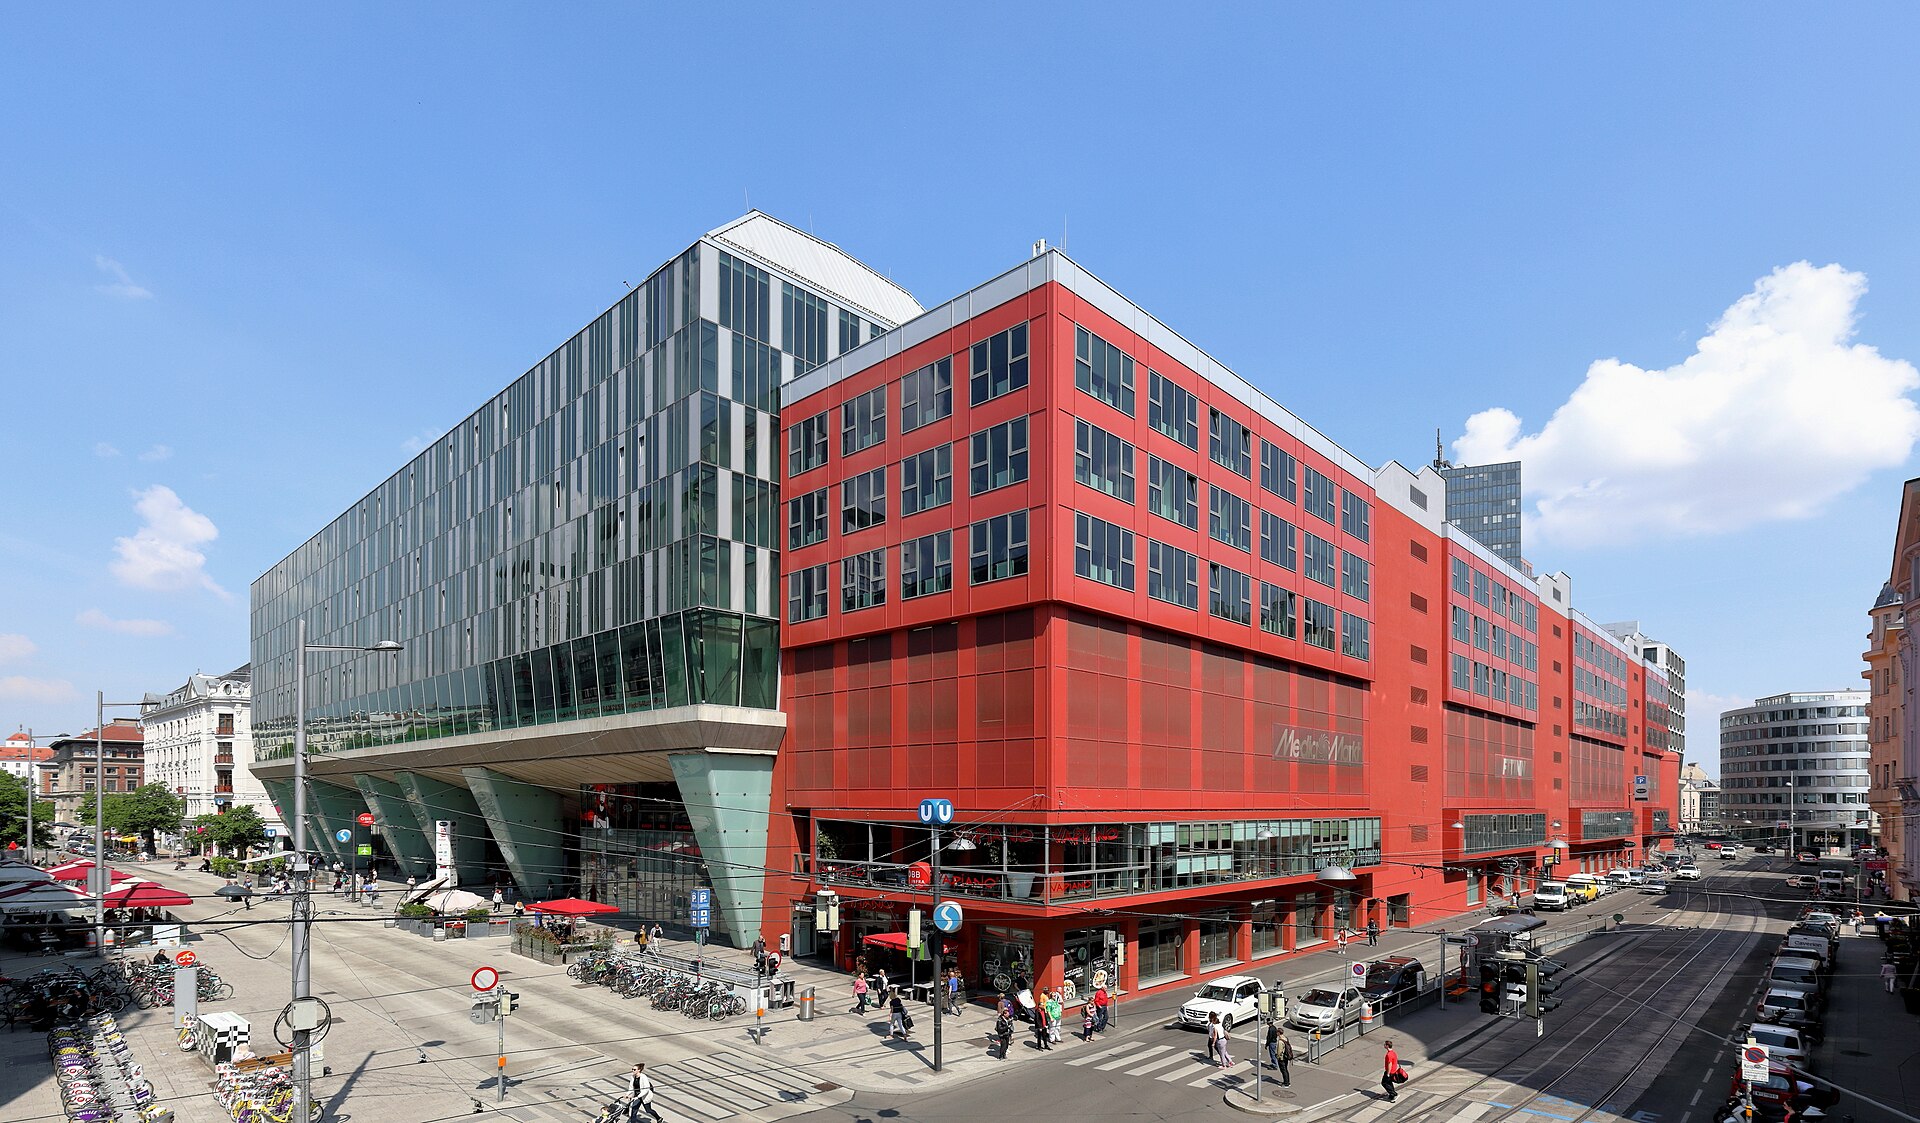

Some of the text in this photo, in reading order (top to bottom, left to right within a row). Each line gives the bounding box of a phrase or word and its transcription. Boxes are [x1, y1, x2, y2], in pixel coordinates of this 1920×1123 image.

[921, 805, 951, 821] U U
[267, 830, 276, 838] U
[1051, 880, 1091, 892] VAPIANO
[700, 894, 706, 903] P
[1794, 940, 1823, 948] Caverion
